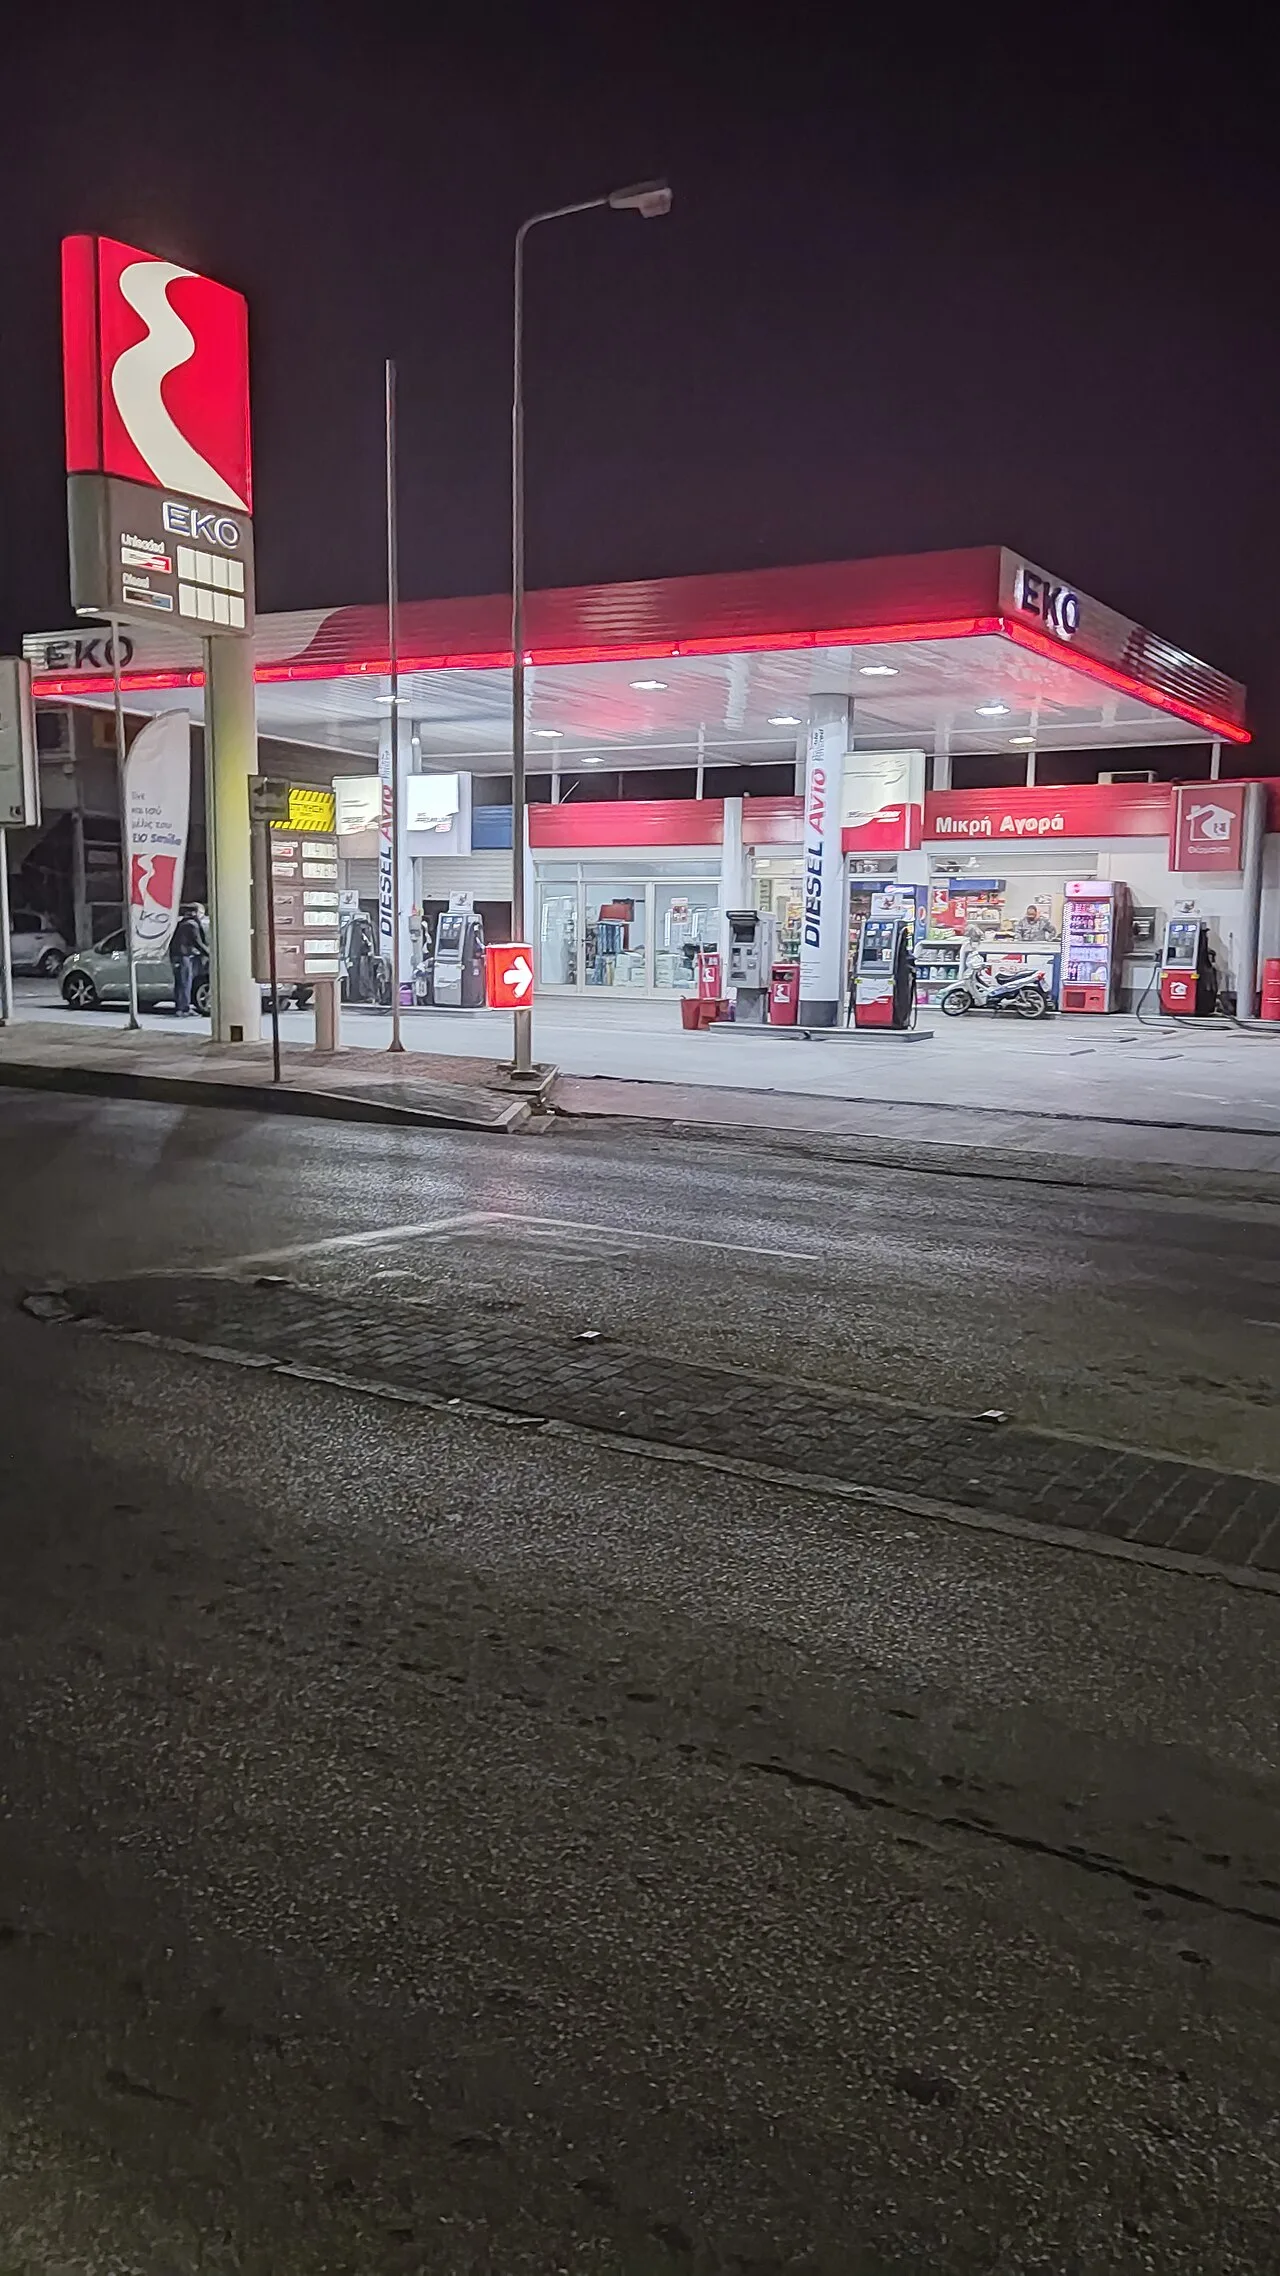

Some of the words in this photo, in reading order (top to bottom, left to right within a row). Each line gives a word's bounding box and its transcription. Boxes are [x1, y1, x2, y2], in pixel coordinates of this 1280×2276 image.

[162, 501, 240, 549] EKO
[1020, 569, 1080, 635] EKO
[46, 636, 133, 670] EKO
[381, 784, 394, 843] AVIO
[808, 767, 826, 836] AVIO
[936, 816, 992, 836] Μικρή
[1000, 814, 1064, 835] Αγορά
[380, 847, 393, 937] DIESEL
[804, 841, 825, 948] DIESEL
